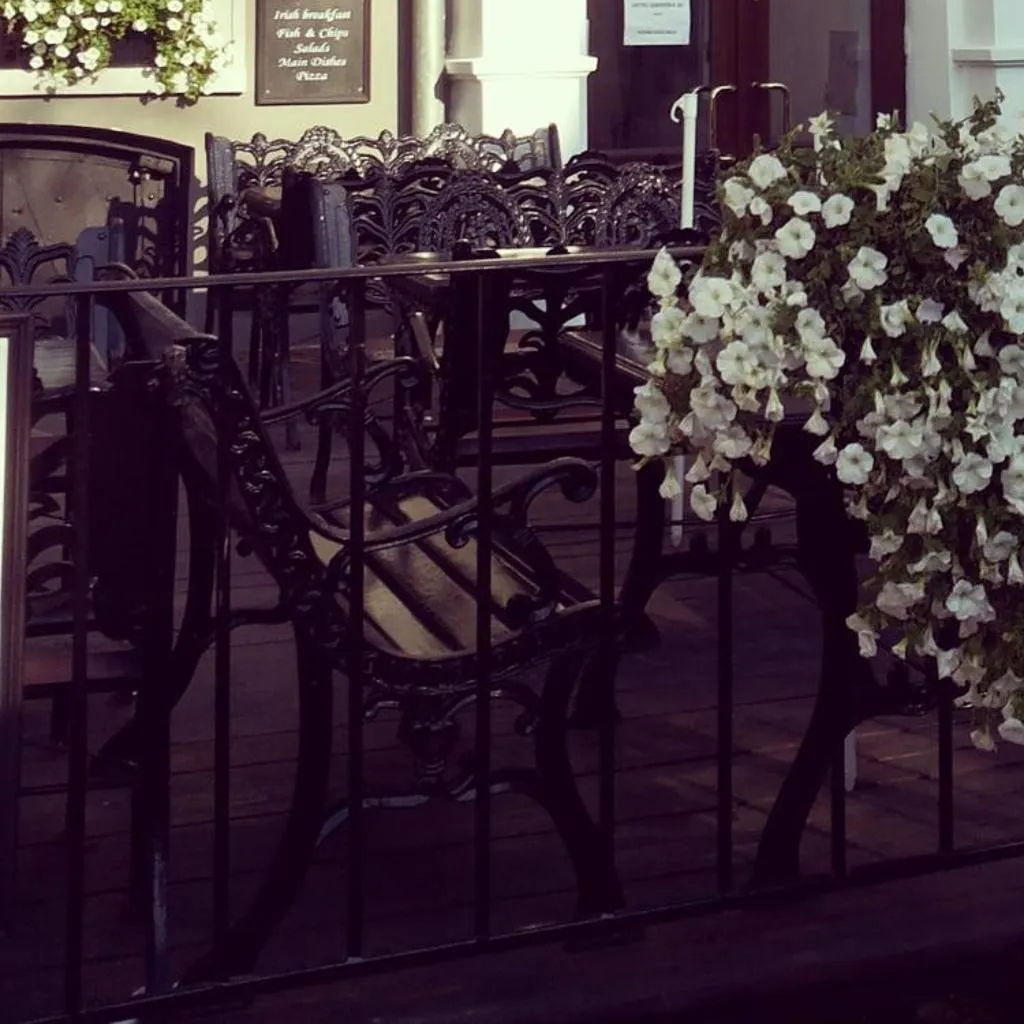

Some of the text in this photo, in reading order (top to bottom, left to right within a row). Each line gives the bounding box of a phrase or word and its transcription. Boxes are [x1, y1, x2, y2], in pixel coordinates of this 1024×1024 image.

[273, 8, 352, 22] Irish breakfast
[276, 27, 350, 40] Fish & Chips
[293, 42, 331, 54] Salads
[277, 56, 347, 68] Main Dishes
[295, 71, 329, 81] Pizza
